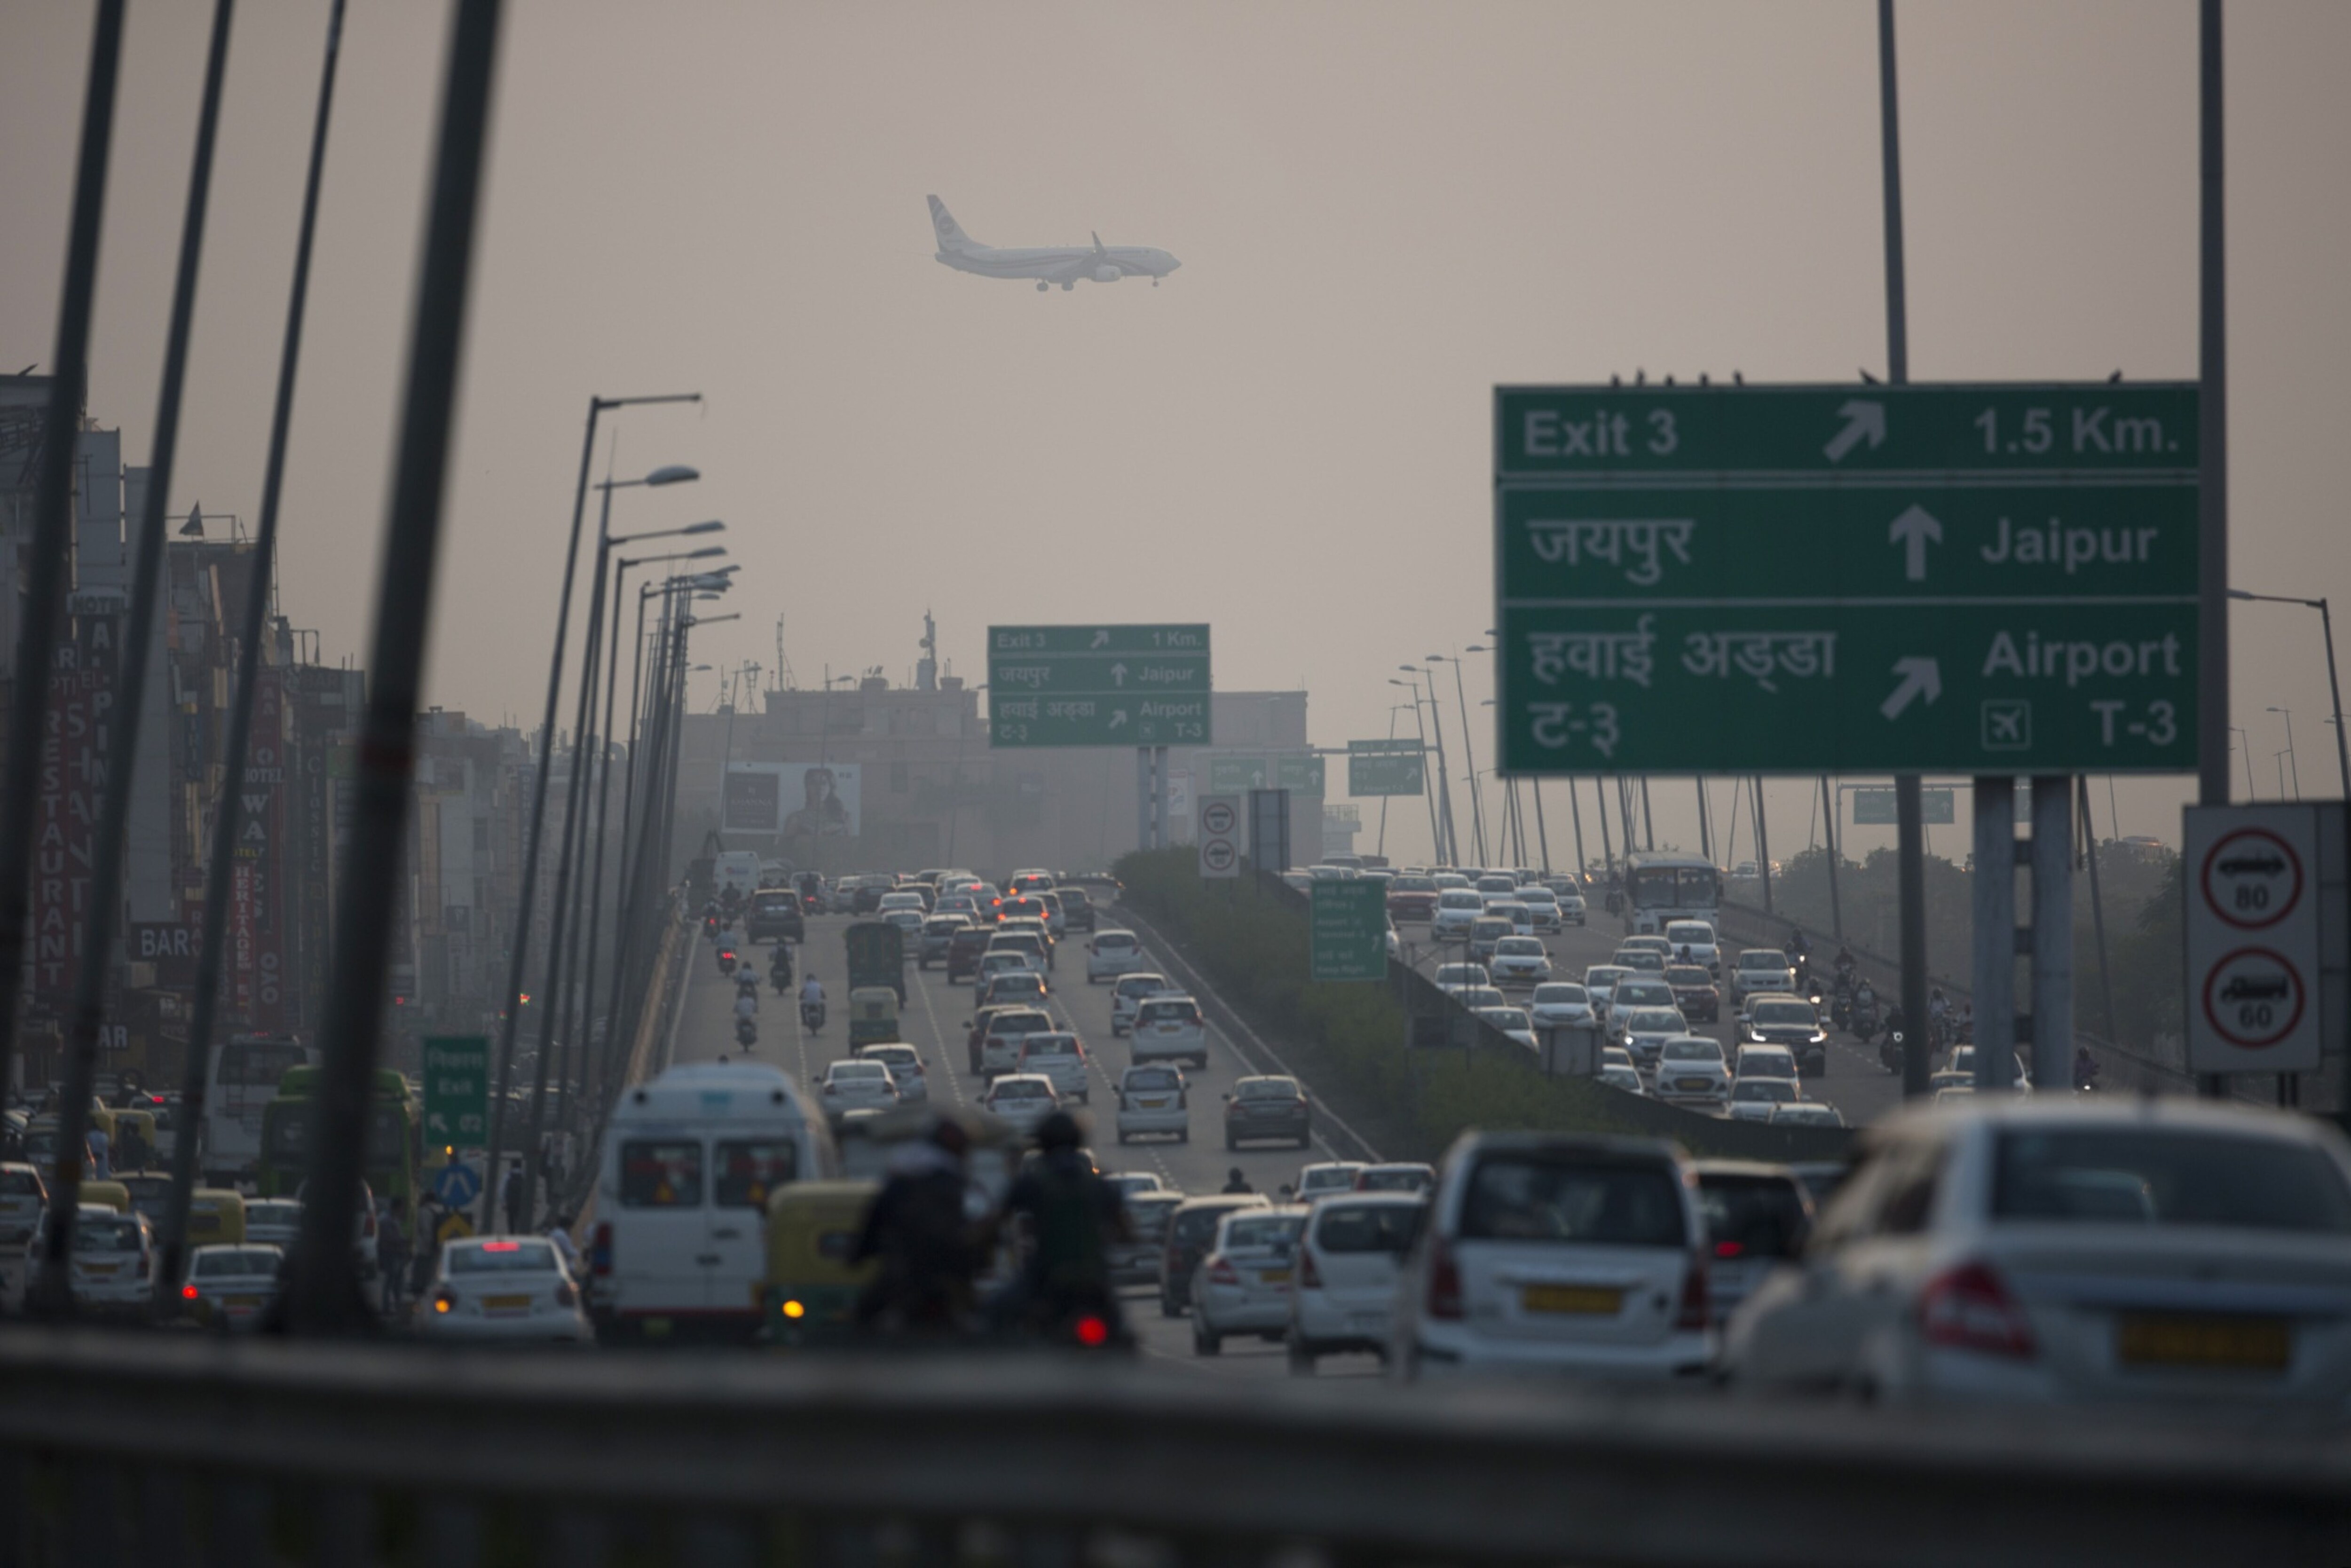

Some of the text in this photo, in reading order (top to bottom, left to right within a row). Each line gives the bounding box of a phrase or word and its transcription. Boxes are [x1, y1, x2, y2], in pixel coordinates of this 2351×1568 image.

[1524, 409, 1678, 456] Exit 3
[1975, 407, 2178, 453] 1.5 Km.
[1526, 518, 1694, 585] जयपुर
[1980, 517, 2158, 575] Jaipur
[997, 632, 1046, 648] Exit 3
[1152, 631, 1202, 646] 1 Km.
[1527, 614, 1656, 687] हवाई
[1982, 630, 2180, 687] Airport
[998, 665, 1051, 688] जयपुर
[1139, 666, 1194, 684] Jaipur
[999, 697, 1039, 721] हवाई
[1139, 701, 1202, 718] Airport
[1175, 722, 1203, 738] T-3
[2090, 700, 2177, 746] T-3
[2235, 884, 2269, 911] 80
[141, 929, 189, 957] BAR
[2239, 1005, 2272, 1029] 60
[98, 1025, 128, 1048] AR
